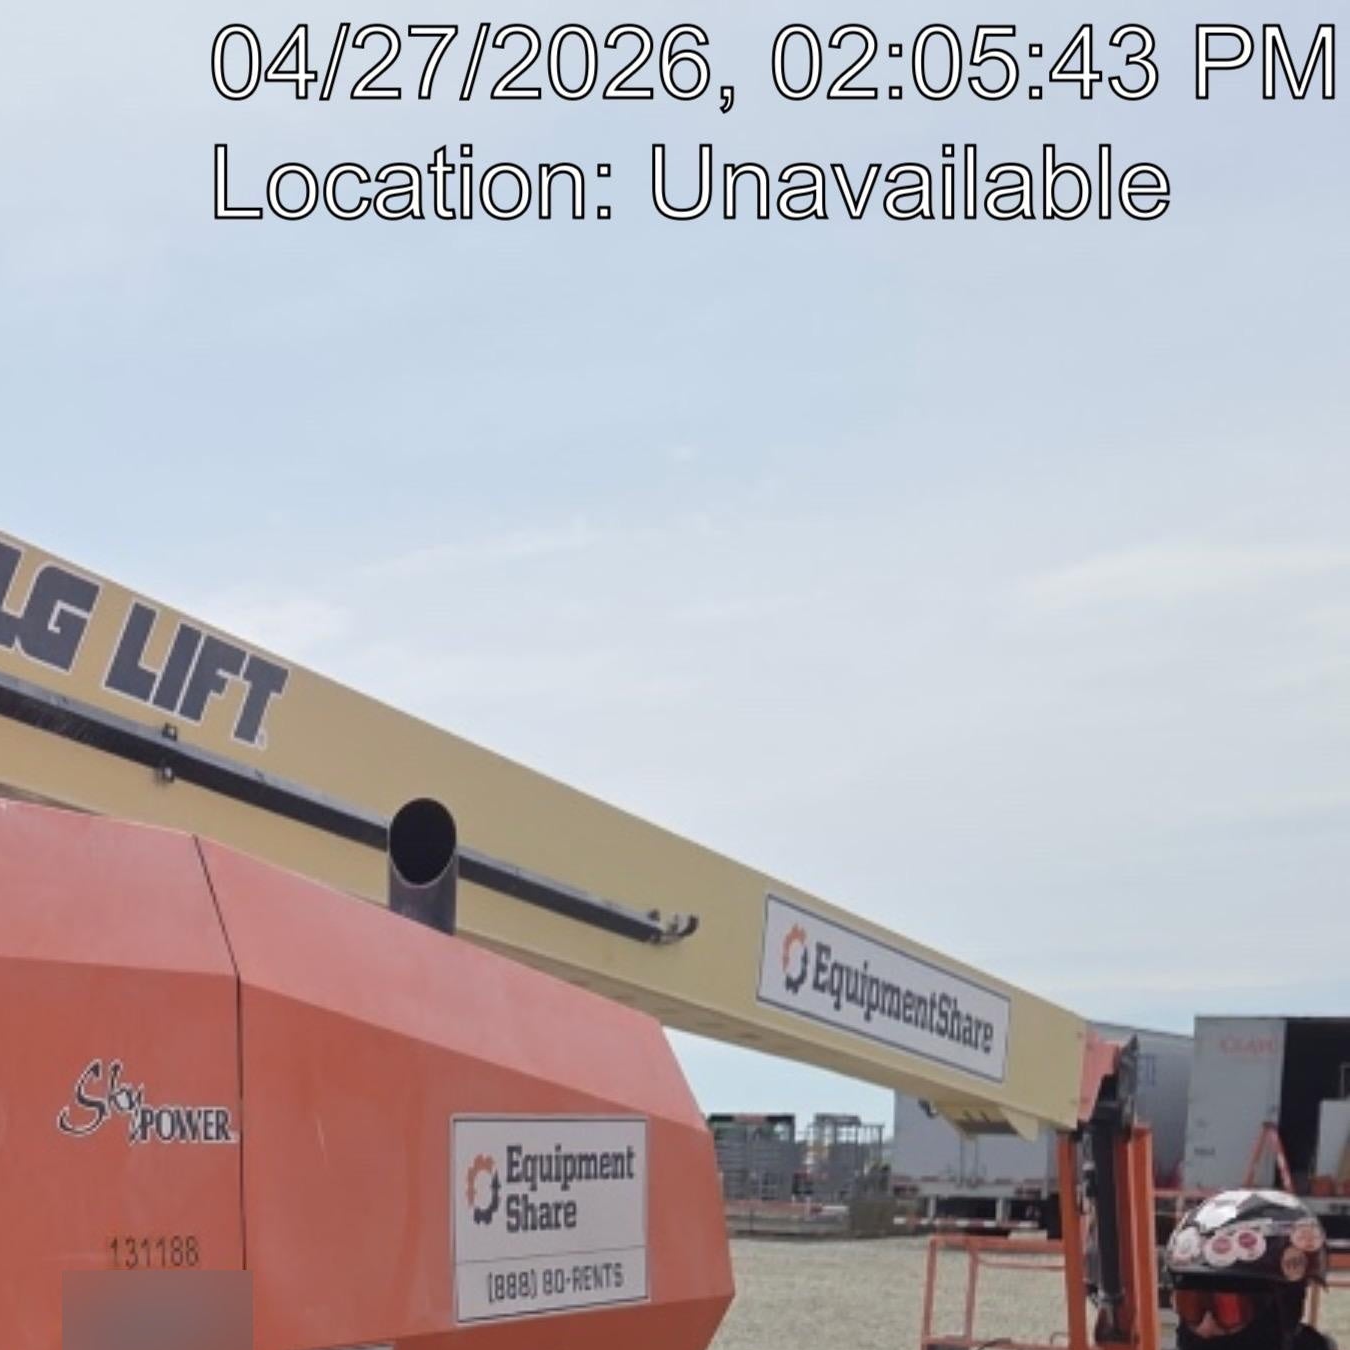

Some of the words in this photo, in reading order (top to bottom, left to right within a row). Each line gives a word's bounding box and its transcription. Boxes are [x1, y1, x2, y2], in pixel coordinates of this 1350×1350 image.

[103, 602, 290, 747] LIFT
[811, 941, 994, 1054] EquipmentShare
[57, 1058, 144, 1146] Sky
[139, 1106, 237, 1143] POWER
[505, 1144, 636, 1192] Equipment
[505, 1193, 577, 1234] Share
[109, 1235, 200, 1268] 131188
[488, 1269, 537, 1303] (888)
[542, 1263, 624, 1295] 80-RENTS
